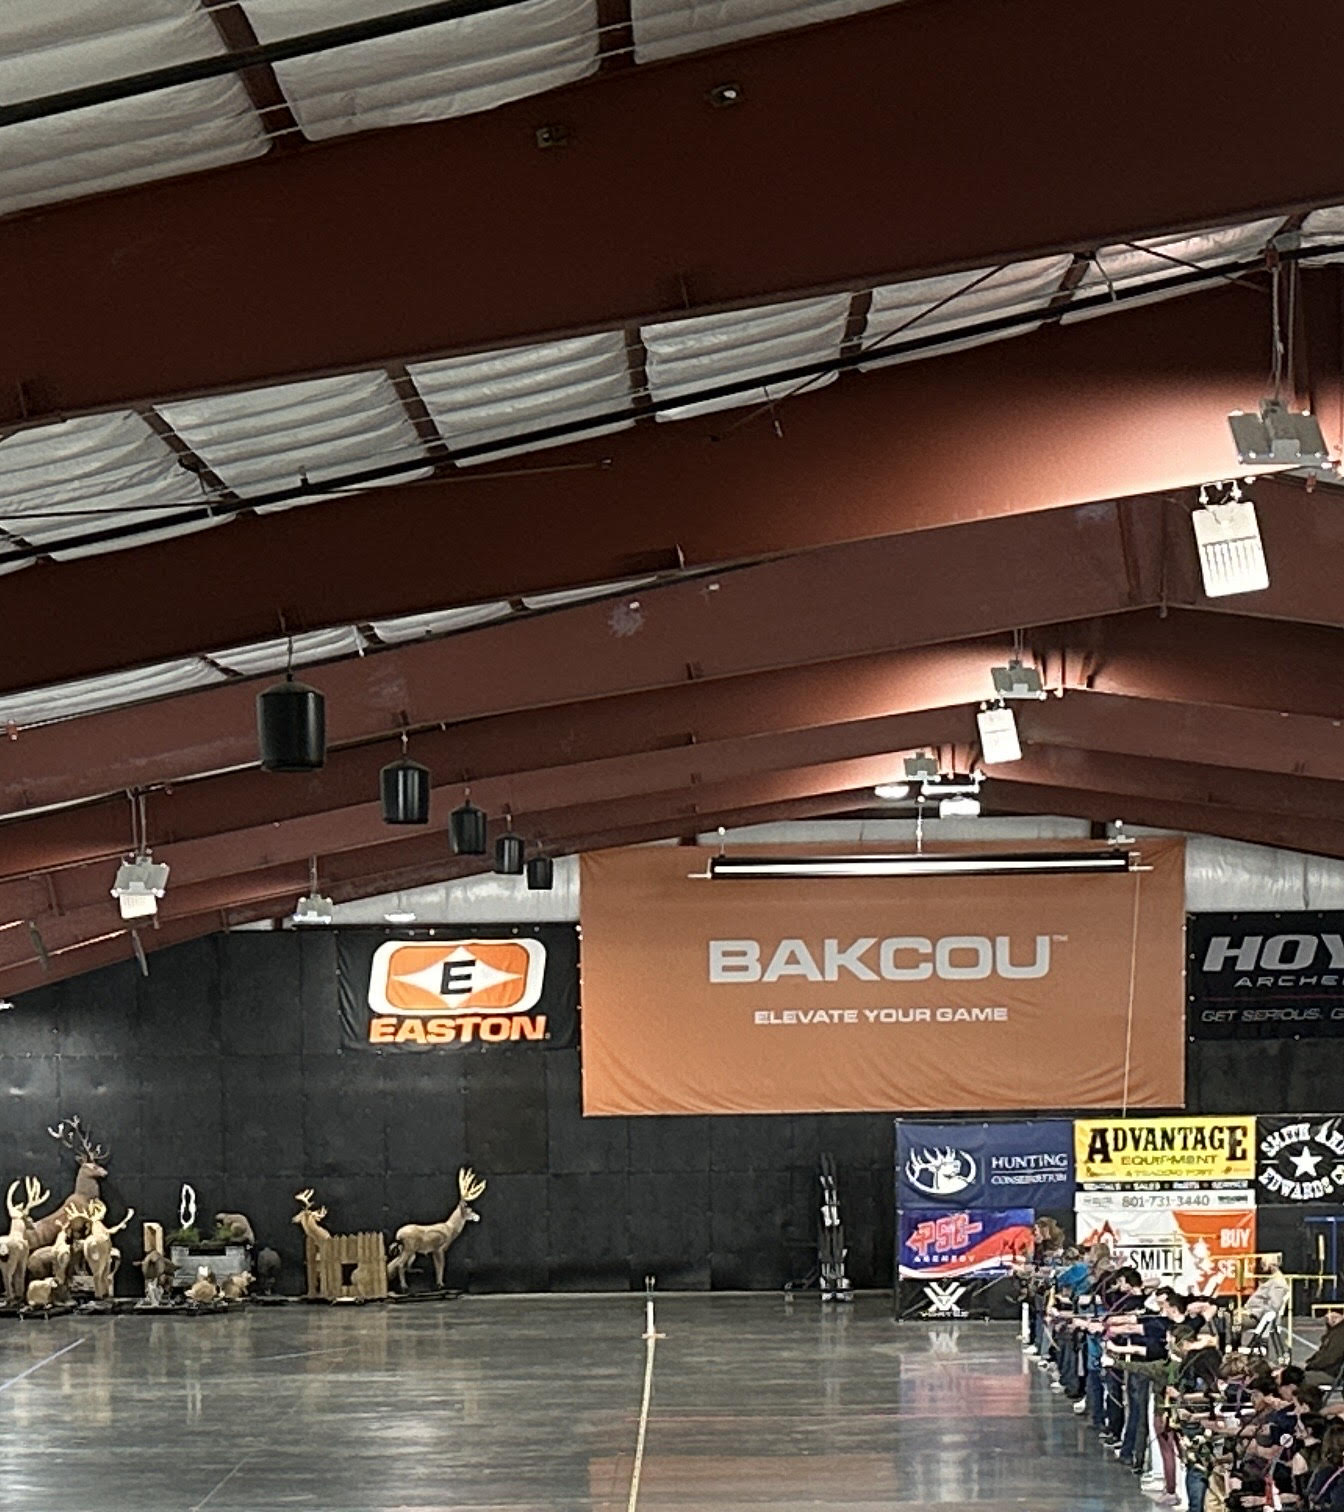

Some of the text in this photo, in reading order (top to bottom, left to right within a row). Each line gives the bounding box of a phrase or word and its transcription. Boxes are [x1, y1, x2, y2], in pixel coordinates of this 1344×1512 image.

[708, 935, 1050, 983] BAKCOU
[440, 959, 476, 995] E
[754, 1006, 1009, 1024] ELEVATE YOUR GAME
[1201, 1009, 1237, 1022] GET
[369, 1015, 547, 1044] EASTON
[1085, 1125, 1248, 1164] ADVANTAGE
[1260, 1122, 1311, 1158] SMITH
[991, 1154, 1068, 1169] HUNTING
[1121, 1155, 1218, 1166] EQUIPMENT
[1258, 1166, 1334, 1200] EDWARDS
[1121, 1195, 1211, 1208] 801-731-3440
[1220, 1229, 1250, 1248] BUY
[1129, 1249, 1183, 1271] SMITH
